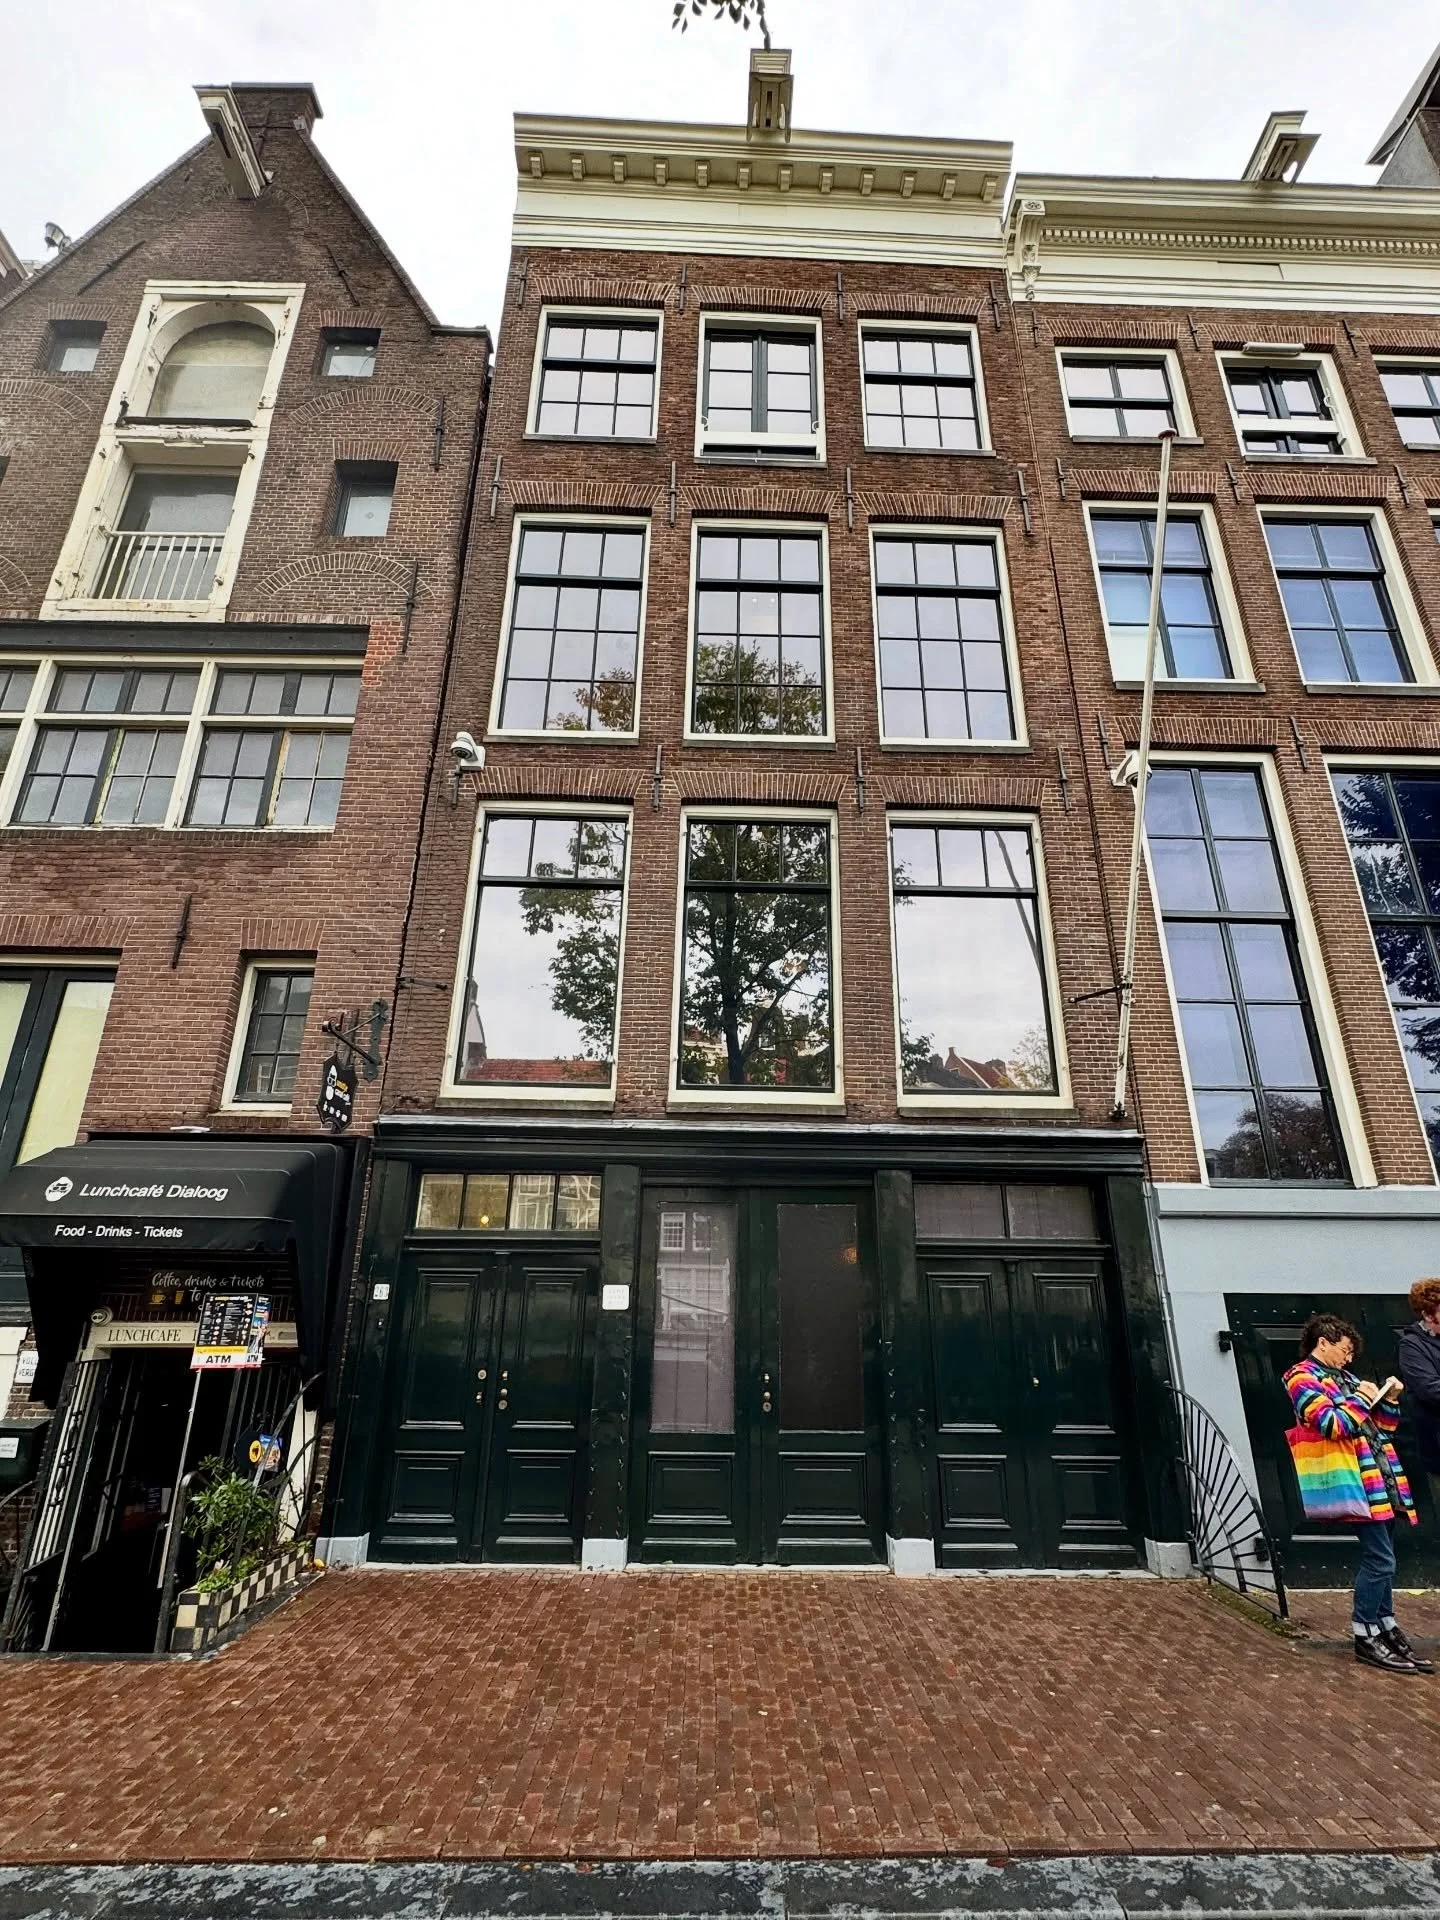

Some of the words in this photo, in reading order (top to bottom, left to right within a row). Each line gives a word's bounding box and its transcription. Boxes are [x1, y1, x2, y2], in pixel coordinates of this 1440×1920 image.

[79, 1183, 164, 1198] Lunchcafé
[166, 1184, 228, 1202] Dialoog
[54, 1224, 85, 1237] Food
[95, 1225, 132, 1238] Drinks
[144, 1226, 183, 1238] Tickets
[152, 1272, 182, 1288] Coffee,
[184, 1274, 217, 1288] drinks
[219, 1277, 228, 1286] &
[107, 1329, 182, 1342] LUNCHCAFE
[205, 1355, 232, 1364] ATM
